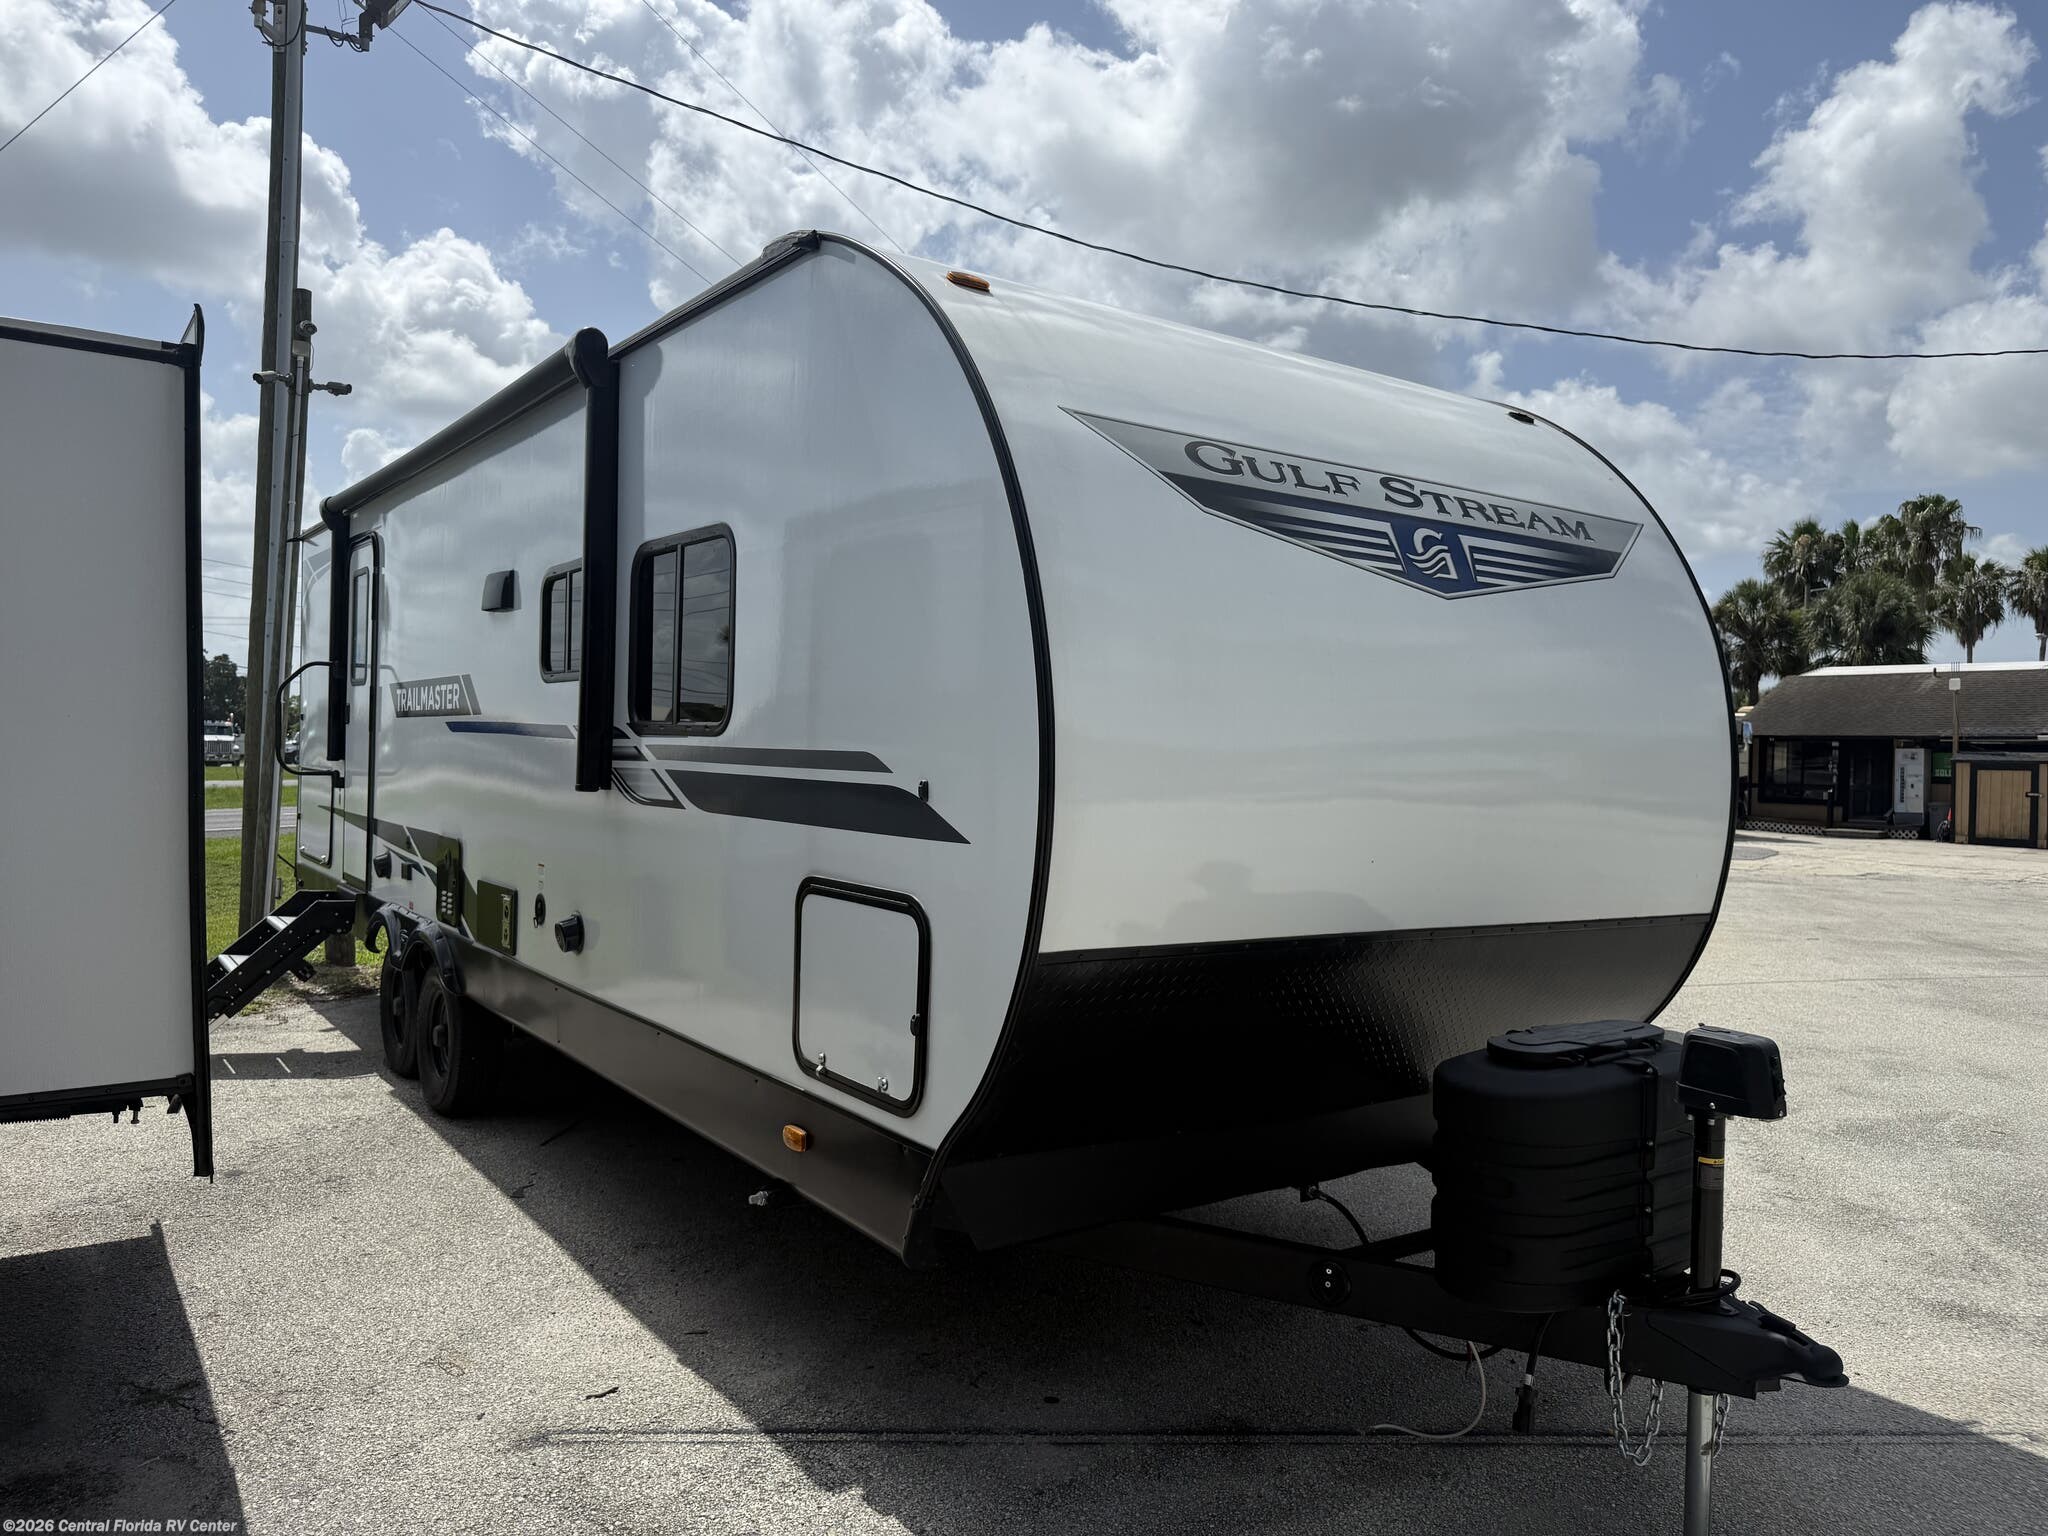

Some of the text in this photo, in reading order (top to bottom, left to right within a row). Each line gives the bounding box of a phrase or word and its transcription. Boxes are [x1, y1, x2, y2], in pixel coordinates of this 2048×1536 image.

[1184, 440, 1596, 543] GULF STREAM
[396, 683, 460, 711] TRAILMASTER
